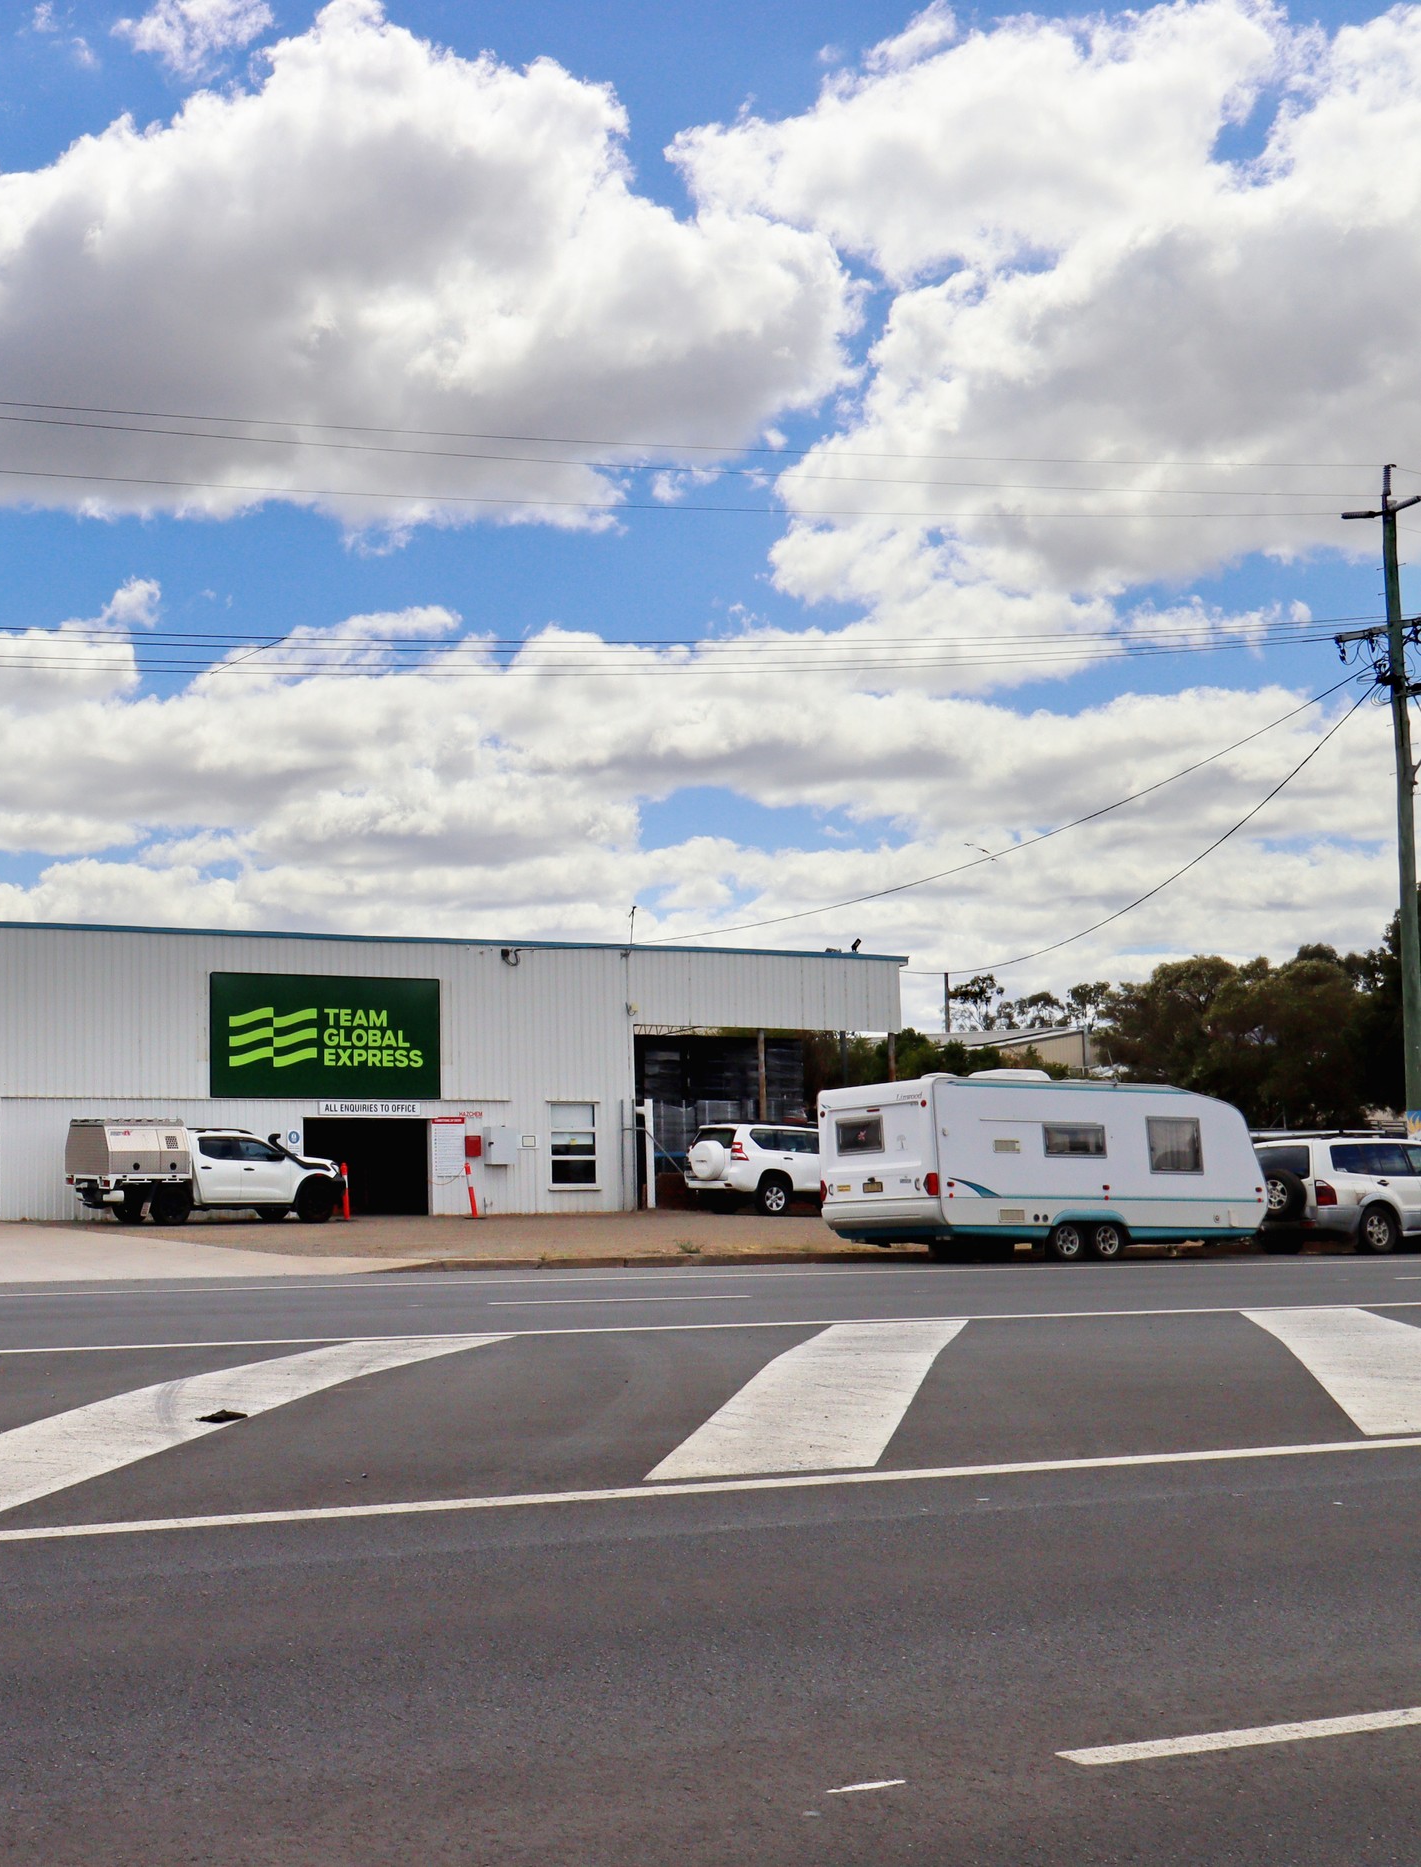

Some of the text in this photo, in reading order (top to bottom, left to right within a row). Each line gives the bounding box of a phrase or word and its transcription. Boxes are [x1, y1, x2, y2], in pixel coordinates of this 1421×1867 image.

[323, 1008, 387, 1027] TEAM
[323, 1028, 410, 1047] GLOBAL
[323, 1048, 424, 1068] EXPRESS
[324, 1103, 416, 1113] ALL ENQUIRIES TO OFFICE
